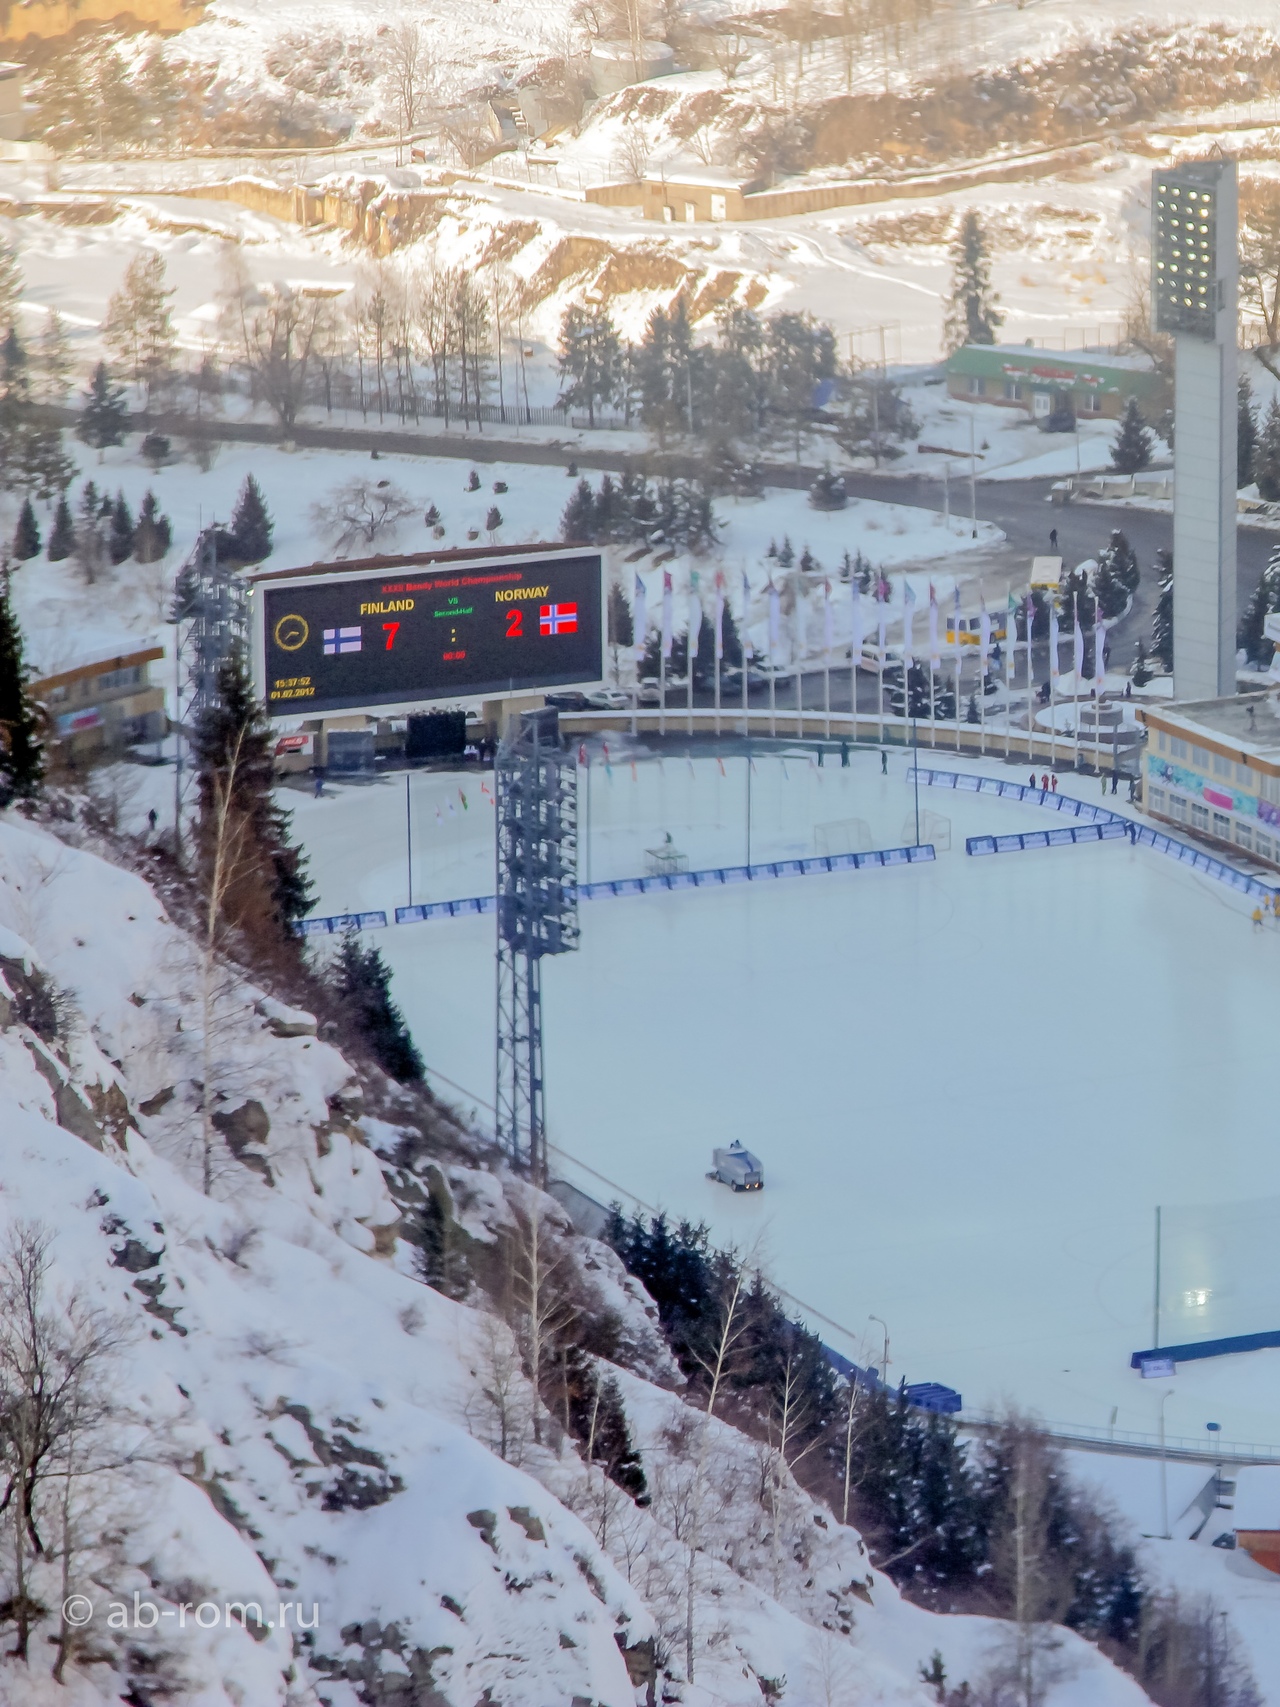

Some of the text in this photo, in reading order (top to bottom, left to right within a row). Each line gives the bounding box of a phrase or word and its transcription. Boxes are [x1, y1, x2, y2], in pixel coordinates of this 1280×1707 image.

[405, 581, 433, 591] Bandy
[434, 577, 460, 588] World
[461, 572, 522, 586] Championship
[495, 586, 549, 603] NORWAY
[360, 599, 414, 615] FINLAND
[382, 622, 400, 651] 7
[505, 609, 524, 637] 2
[276, 676, 311, 688] 15:37:52
[270, 687, 315, 700] 01.02.2012
